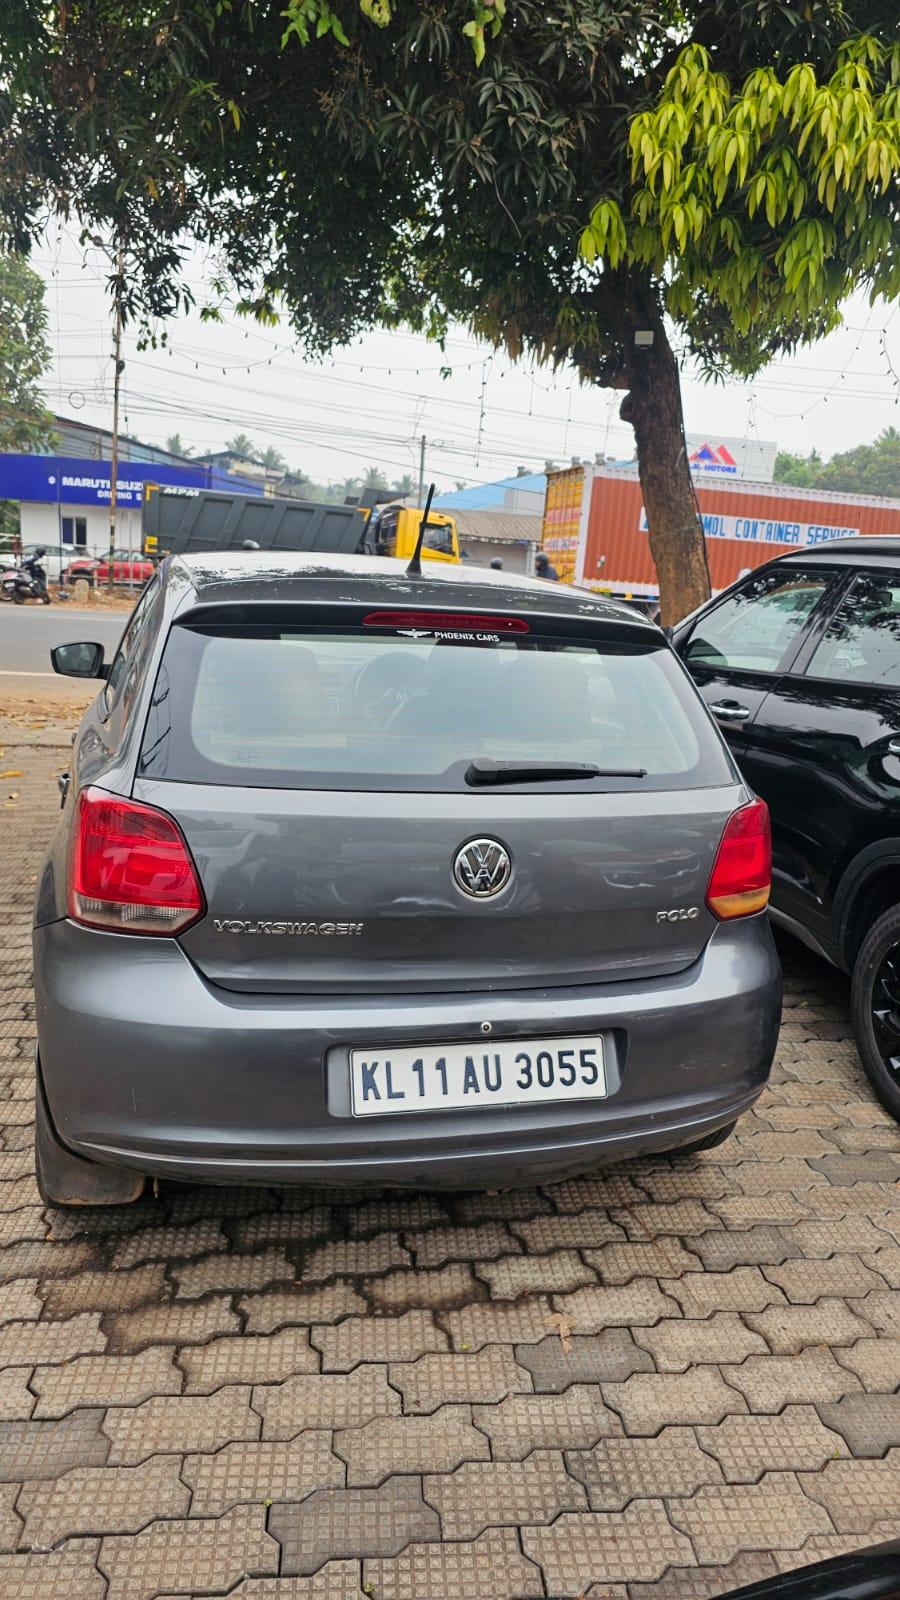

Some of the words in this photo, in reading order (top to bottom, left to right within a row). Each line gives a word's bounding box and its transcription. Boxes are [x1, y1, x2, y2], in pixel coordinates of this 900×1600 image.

[62, 476, 111, 489] MARUTI
[116, 480, 143, 491] SUZ
[97, 490, 132, 500] DRIING
[735, 519, 800, 543] CONTAINER
[434, 631, 475, 641] PHOENIX
[477, 633, 500, 642] CARS
[656, 907, 699, 923] POLO
[213, 919, 364, 935] VOLKSWAGEN
[463, 1054, 502, 1094] AU
[514, 1049, 599, 1090] 3055
